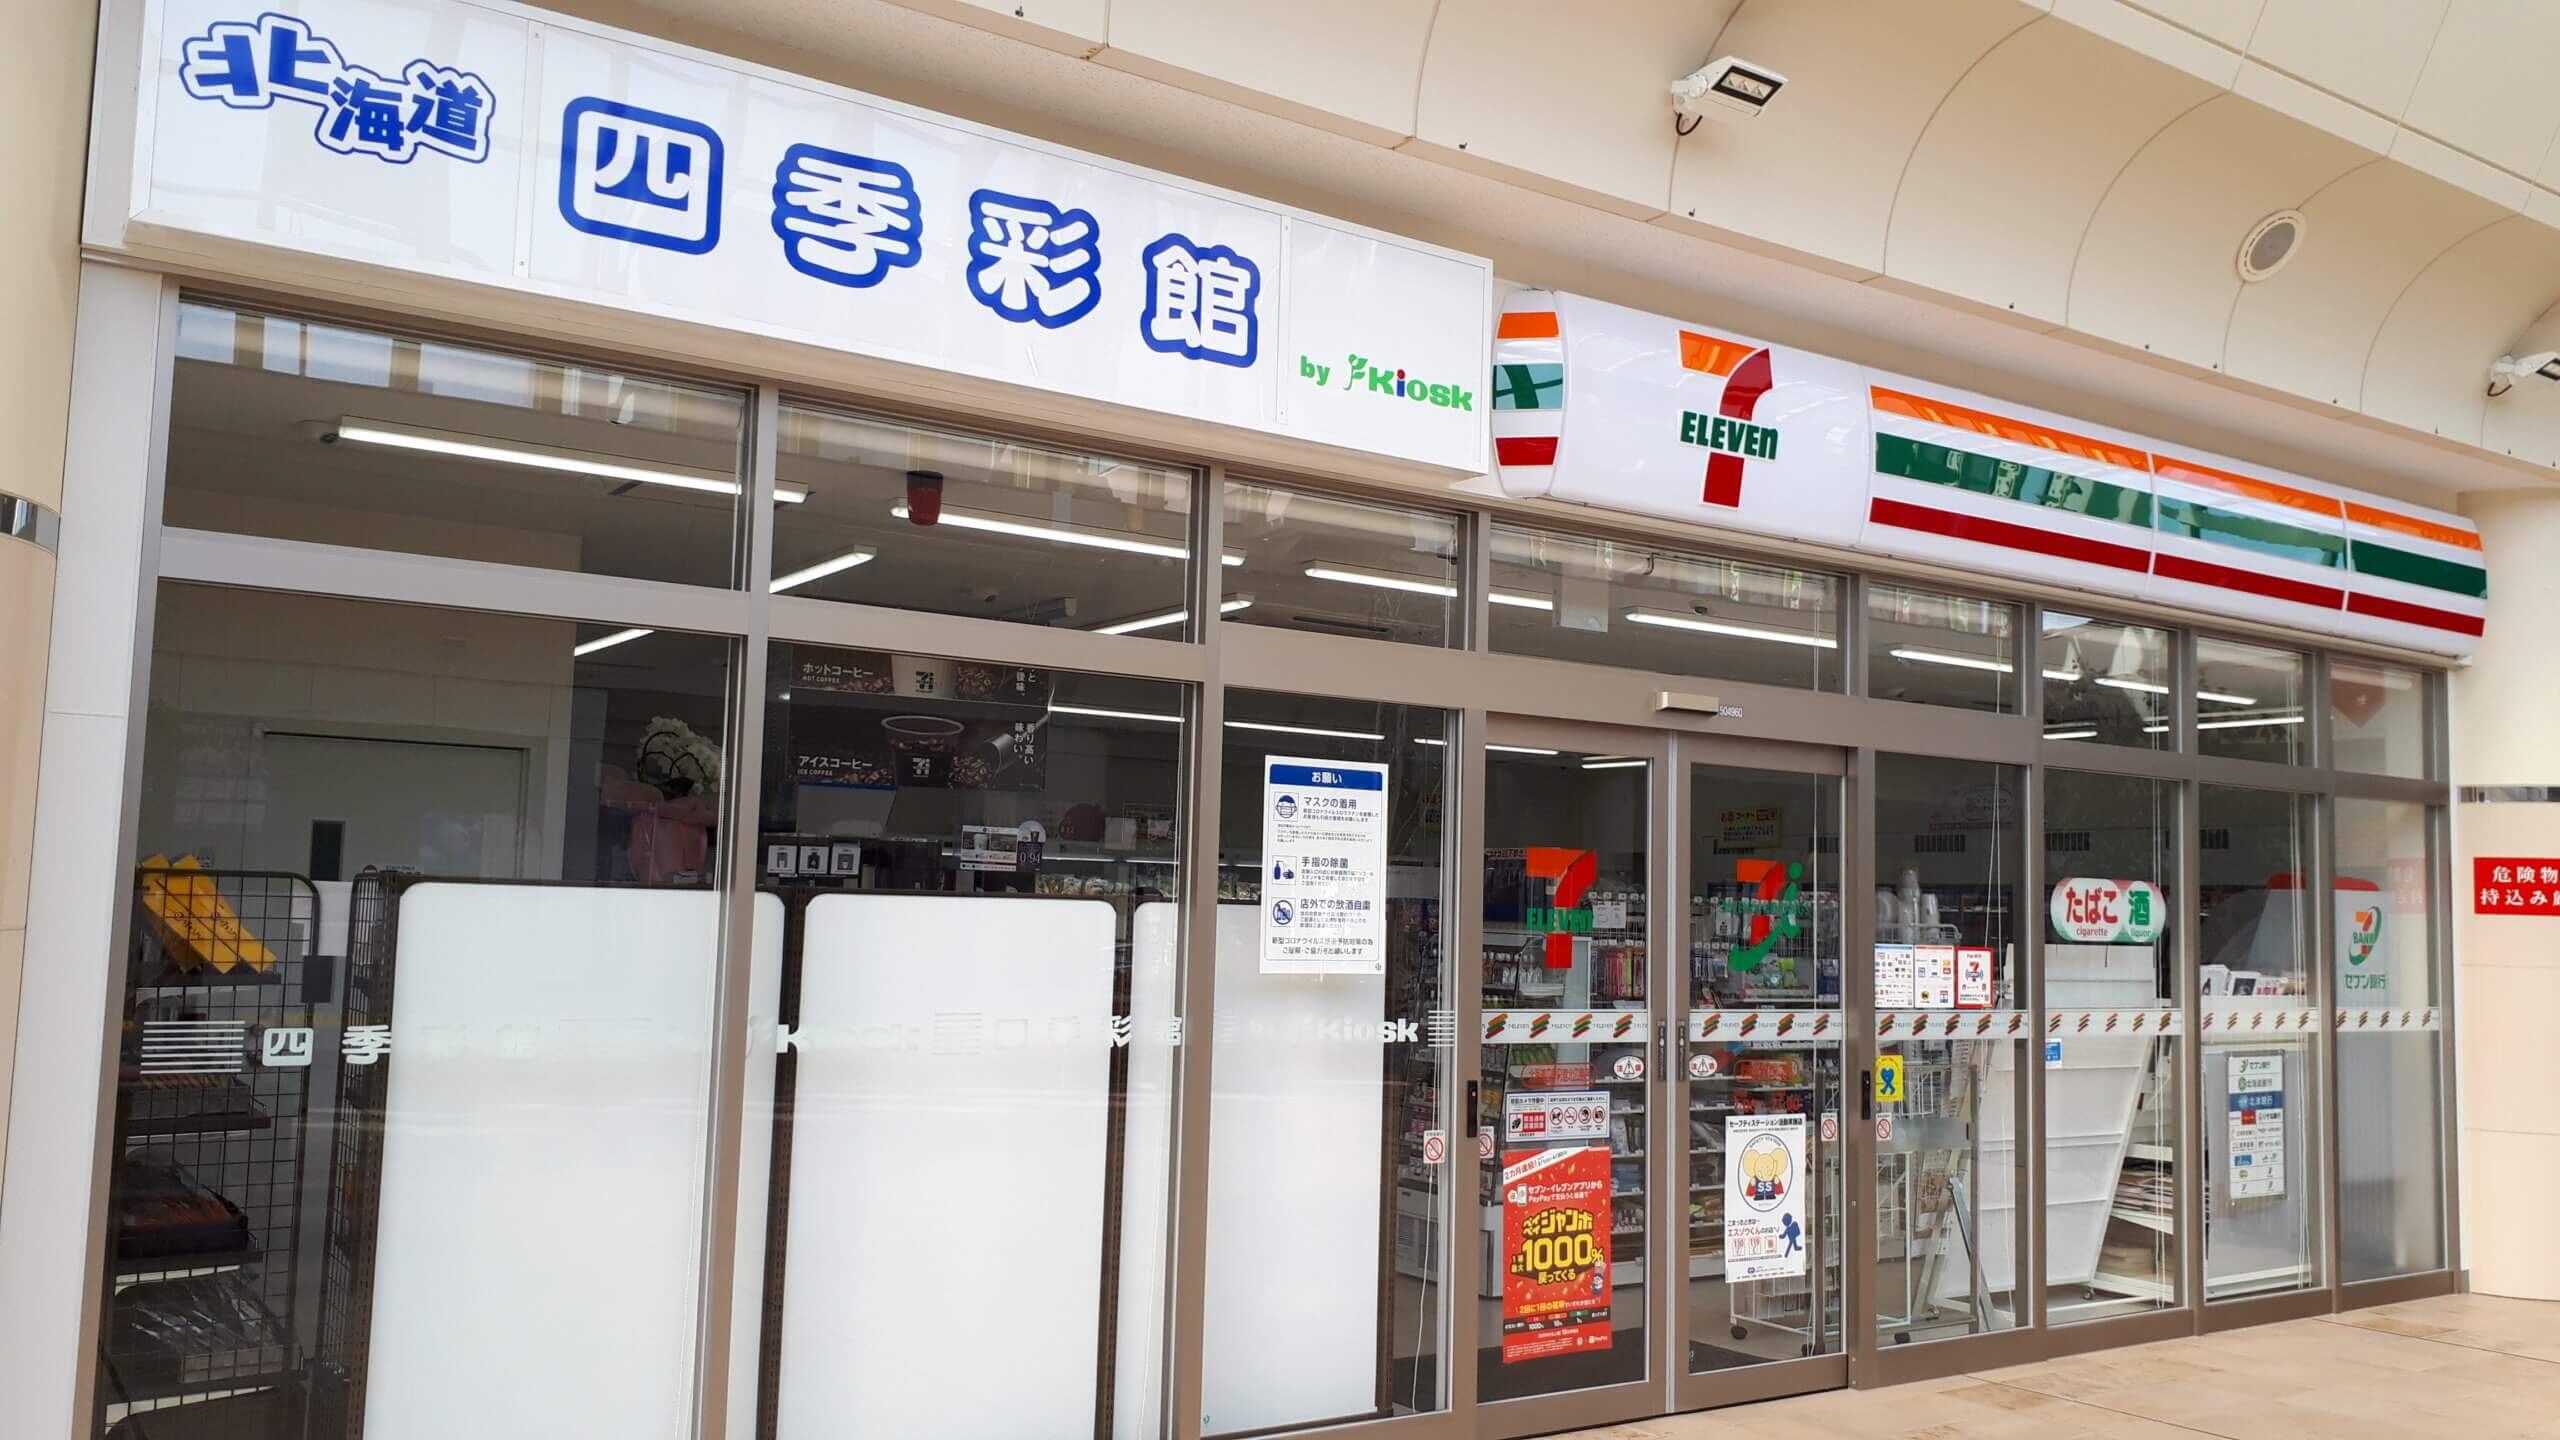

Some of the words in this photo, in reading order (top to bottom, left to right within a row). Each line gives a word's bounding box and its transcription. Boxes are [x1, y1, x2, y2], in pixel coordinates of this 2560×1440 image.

[180, 12, 496, 163] 北海道
[559, 96, 1259, 368] 四季彩館
[1300, 355, 1330, 386] by
[1368, 366, 1473, 412] Kiosk
[802, 663, 874, 678] ホットコーヒー
[799, 756, 873, 770] アイスコーヒー
[1312, 771, 1342, 784] お願い
[1303, 796, 1357, 809] マスクの着用
[1301, 856, 1349, 869] 手指の除菌
[2492, 866, 2559, 883] 危険物
[1300, 898, 1371, 911] 店外での飲酒自粛
[2066, 887, 2118, 924] たばこ
[2128, 890, 2150, 925] 酒
[2076, 927, 2109, 937] cigarette
[2345, 974, 2386, 989] セブン銀行
[1757, 1182, 1772, 1192] SS
[1541, 1208, 1593, 1234] ジャンボ
[1538, 1268, 1576, 1285] 戻ってくる
